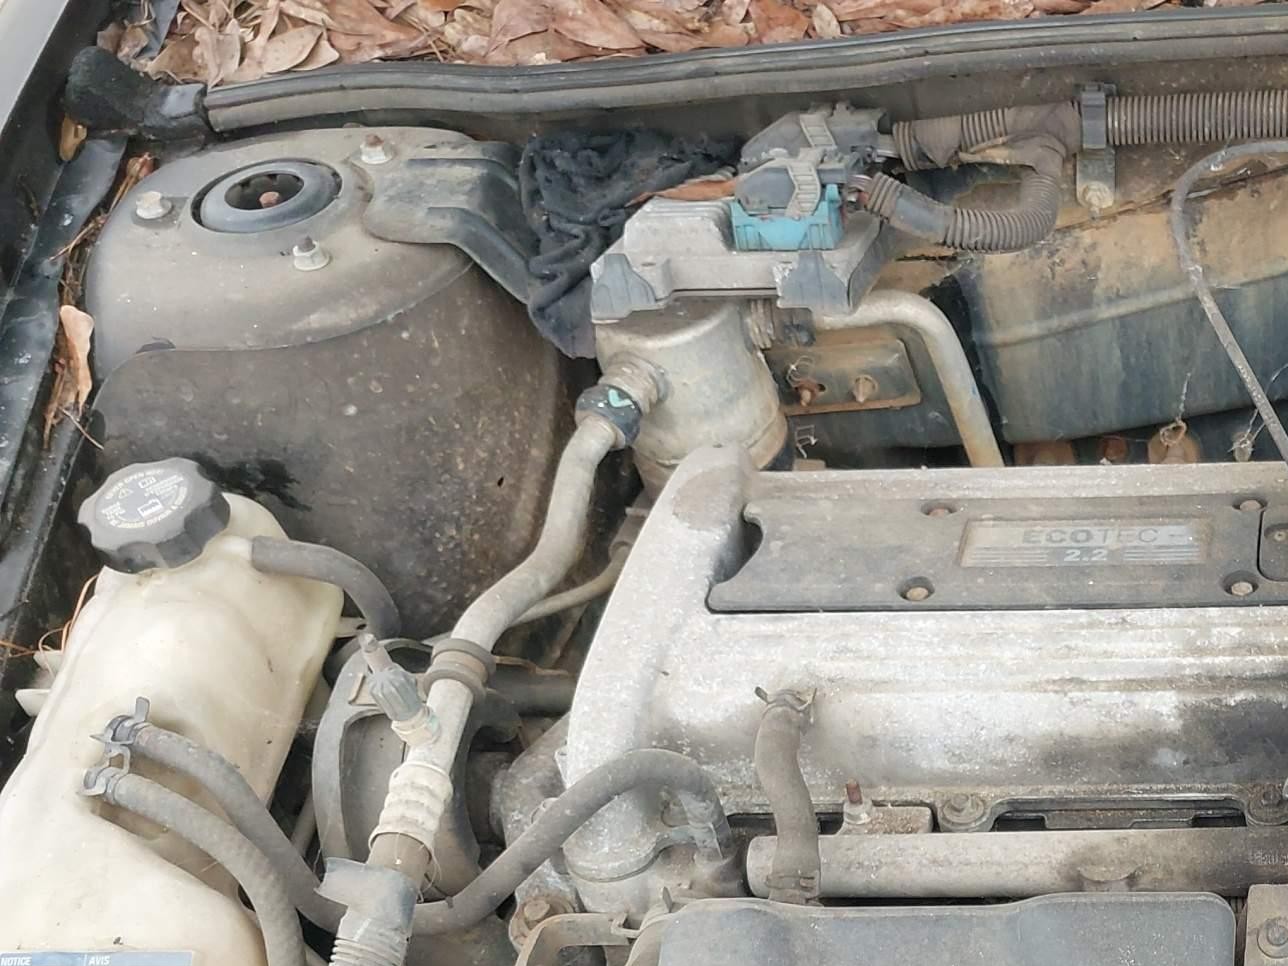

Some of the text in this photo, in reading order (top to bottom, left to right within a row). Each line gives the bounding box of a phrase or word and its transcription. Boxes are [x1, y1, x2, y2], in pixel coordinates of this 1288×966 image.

[1021, 527, 1159, 544] ECOTEC
[1063, 549, 1108, 562] 2.2
[0, 956, 32, 966] NOTICE
[88, 955, 110, 966] AVIS
